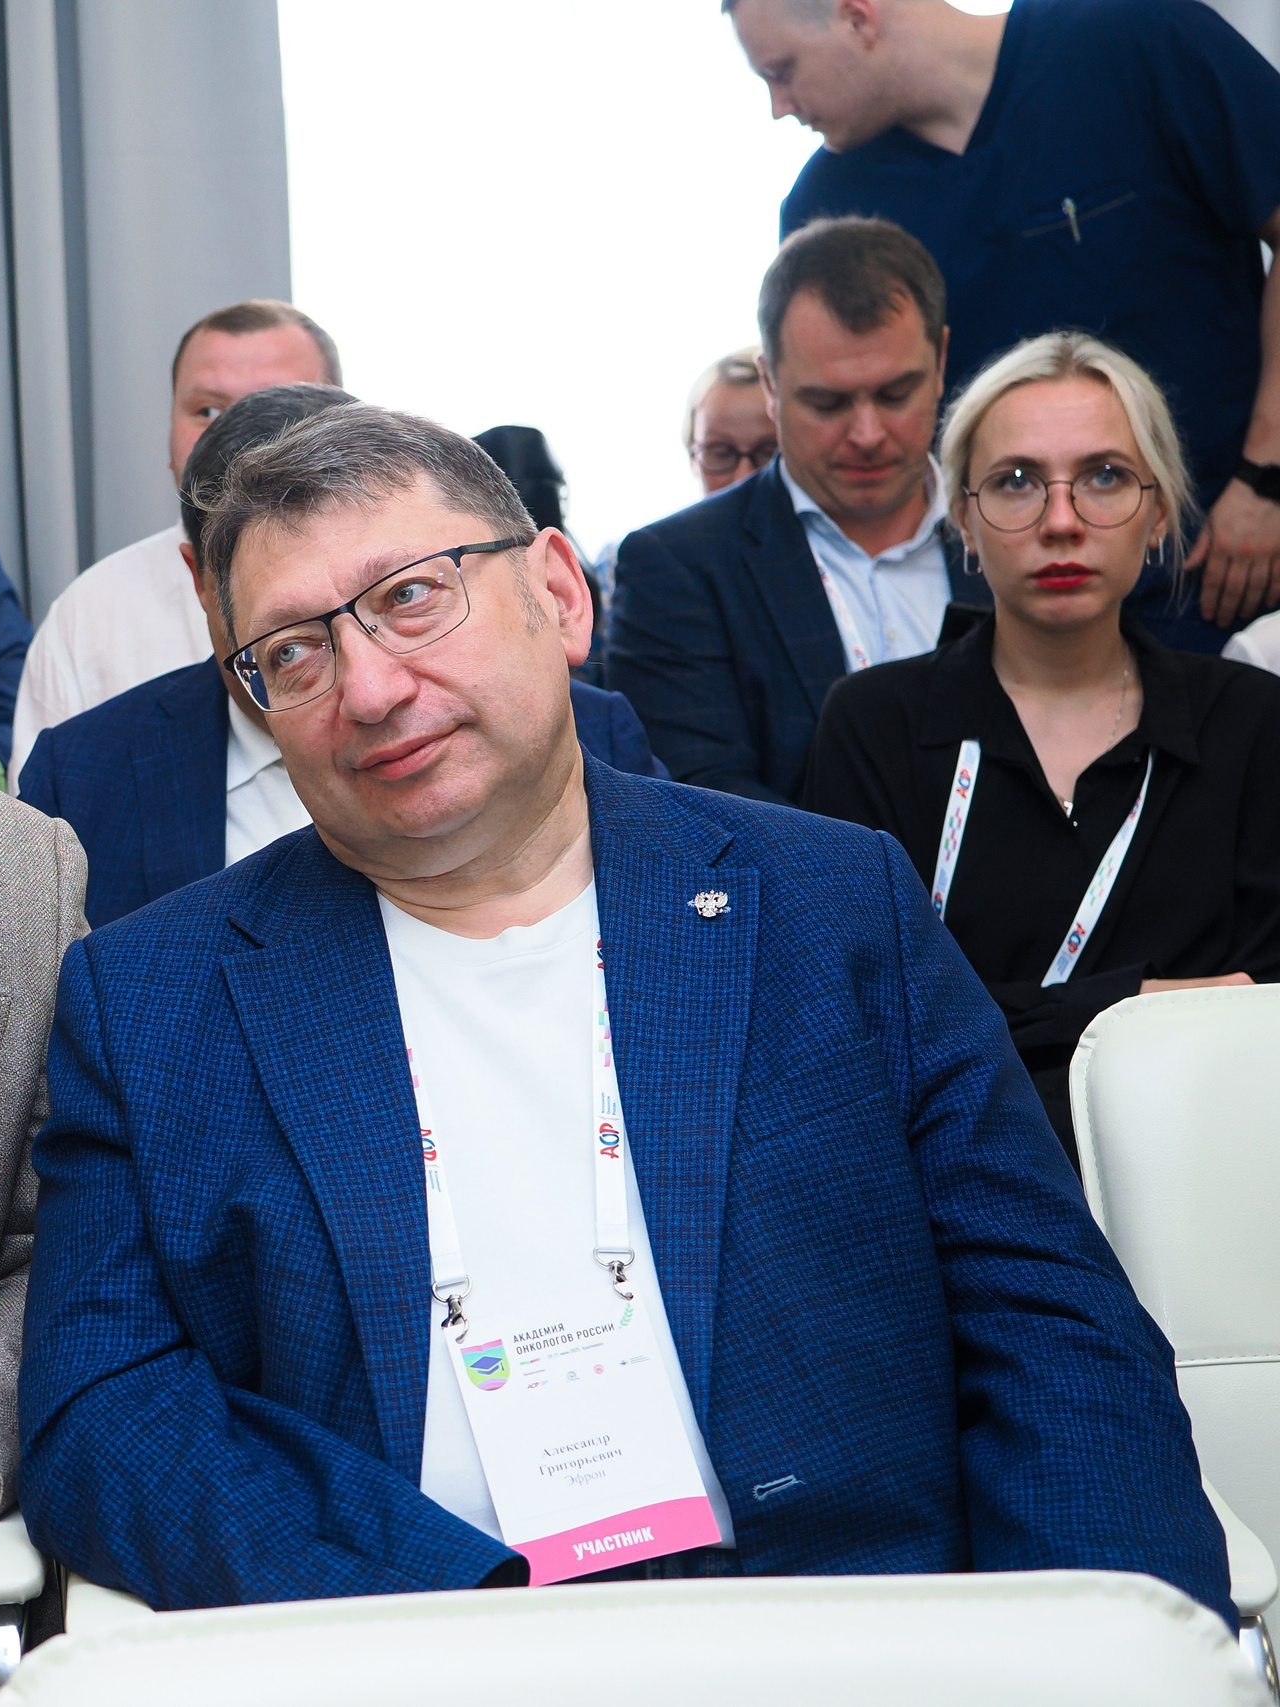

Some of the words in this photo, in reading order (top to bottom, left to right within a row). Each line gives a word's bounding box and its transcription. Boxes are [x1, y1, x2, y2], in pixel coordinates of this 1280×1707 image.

[599, 1122, 620, 1159] АОР
[513, 1322, 565, 1344] АКАДЕМИЯ
[516, 1333, 574, 1355] ОНКОЛОГОВ
[576, 1323, 615, 1340] РОССИИ
[542, 1434, 611, 1459] Александр
[538, 1448, 623, 1477] Григорьевич
[572, 1526, 655, 1561] УЧАСТНИК
